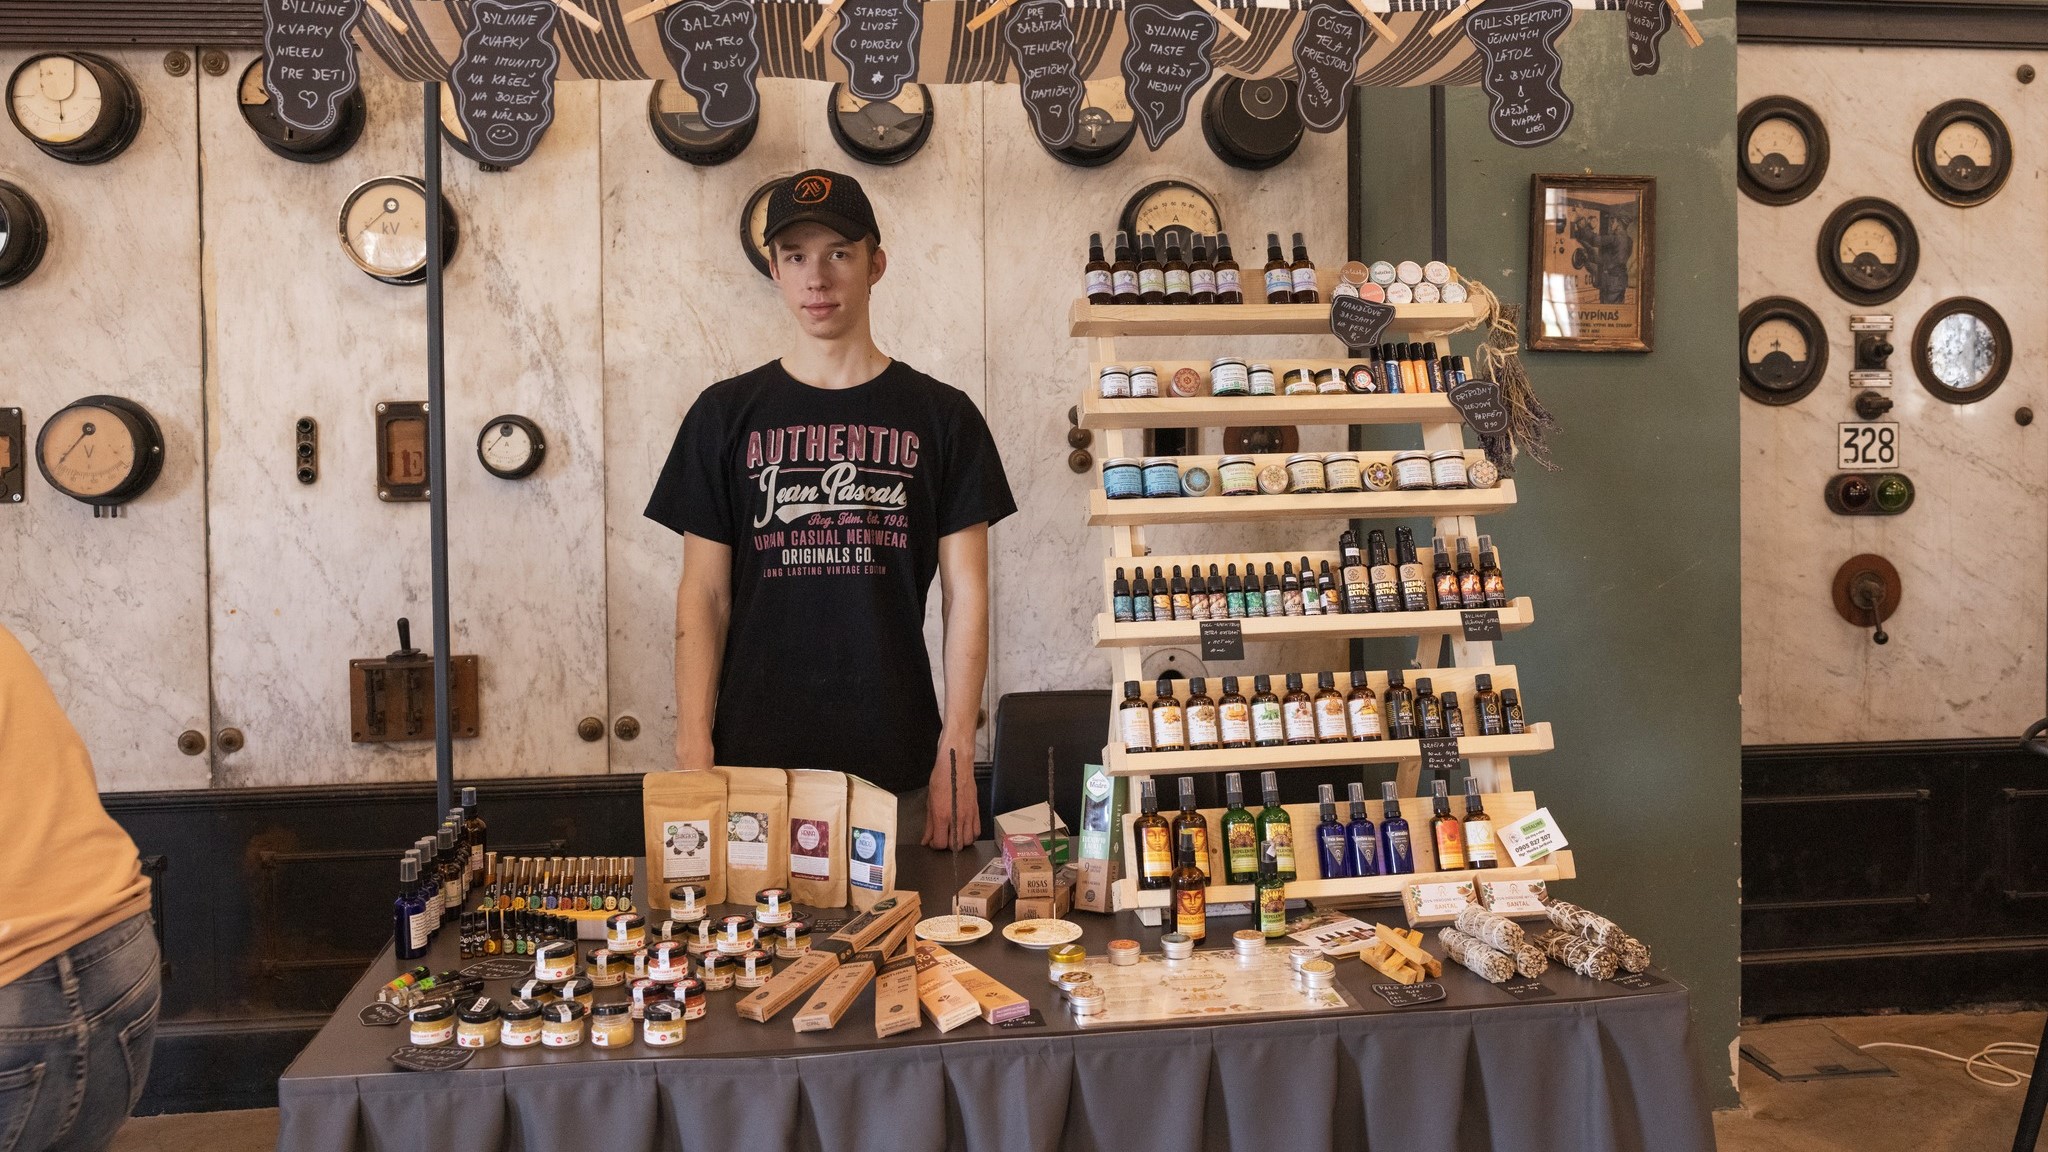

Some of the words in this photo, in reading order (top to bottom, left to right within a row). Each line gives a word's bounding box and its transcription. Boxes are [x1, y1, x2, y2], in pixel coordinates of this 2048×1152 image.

[482, 7, 545, 26] BYLINNÉ
[853, 6, 903, 18] STAROST-
[1027, 7, 1044, 17] PRE
[681, 11, 750, 32] BALZAMY
[860, 18, 899, 31] LIVOSŤ
[1317, 15, 1353, 39] OČISTA
[277, 23, 333, 39] KVAPKY
[1145, 23, 1205, 41] BYLINNÉ
[479, 34, 530, 50] KVAPKY
[694, 40, 713, 52] NA
[850, 39, 857, 48] O
[860, 39, 903, 50] POKOŽKU
[1149, 43, 1186, 56] MASTE
[1316, 34, 1343, 53] TELA
[276, 45, 324, 58] NIELEN
[864, 54, 899, 63] HLAVY
[1495, 47, 1534, 63] LÁTOK
[471, 54, 488, 64] NA
[494, 56, 547, 68] IMUNITU
[703, 62, 707, 71] I
[712, 53, 747, 70] DUŠU
[281, 66, 304, 80] PRE
[312, 68, 345, 81] DETI
[1029, 63, 1069, 79] DETIČKY
[1138, 62, 1152, 73] NA
[1157, 62, 1200, 78] KAŽDÝ
[1510, 63, 1547, 81] BYLÍN
[467, 73, 484, 85] NA
[1147, 79, 1182, 93] NEDUH
[471, 91, 488, 101] NA
[495, 90, 540, 105] BOLESŤ
[1031, 85, 1075, 100] MAMIČKY
[472, 109, 487, 119] NA
[492, 107, 538, 122] NÁLADU
[1500, 98, 1531, 118] KAŽDÁ
[1511, 112, 1542, 127] KVAPKA
[1172, 214, 1180, 223] A
[382, 222, 400, 236] kV
[1340, 311, 1375, 325] BALZAMY
[1349, 324, 1371, 335] PERY
[84, 445, 94, 458] V
[747, 425, 919, 468] AUTHENTIC
[1844, 428, 1894, 463] 328
[754, 465, 819, 528] Jean
[791, 530, 841, 546] CASUAL
[782, 548, 850, 565] ORIGINALS
[855, 547, 875, 563] CO.
[763, 568, 783, 578] LONG
[787, 567, 822, 576] LASTING
[826, 566, 860, 575] VINTAGE
[1027, 880, 1048, 888] ROSAS
